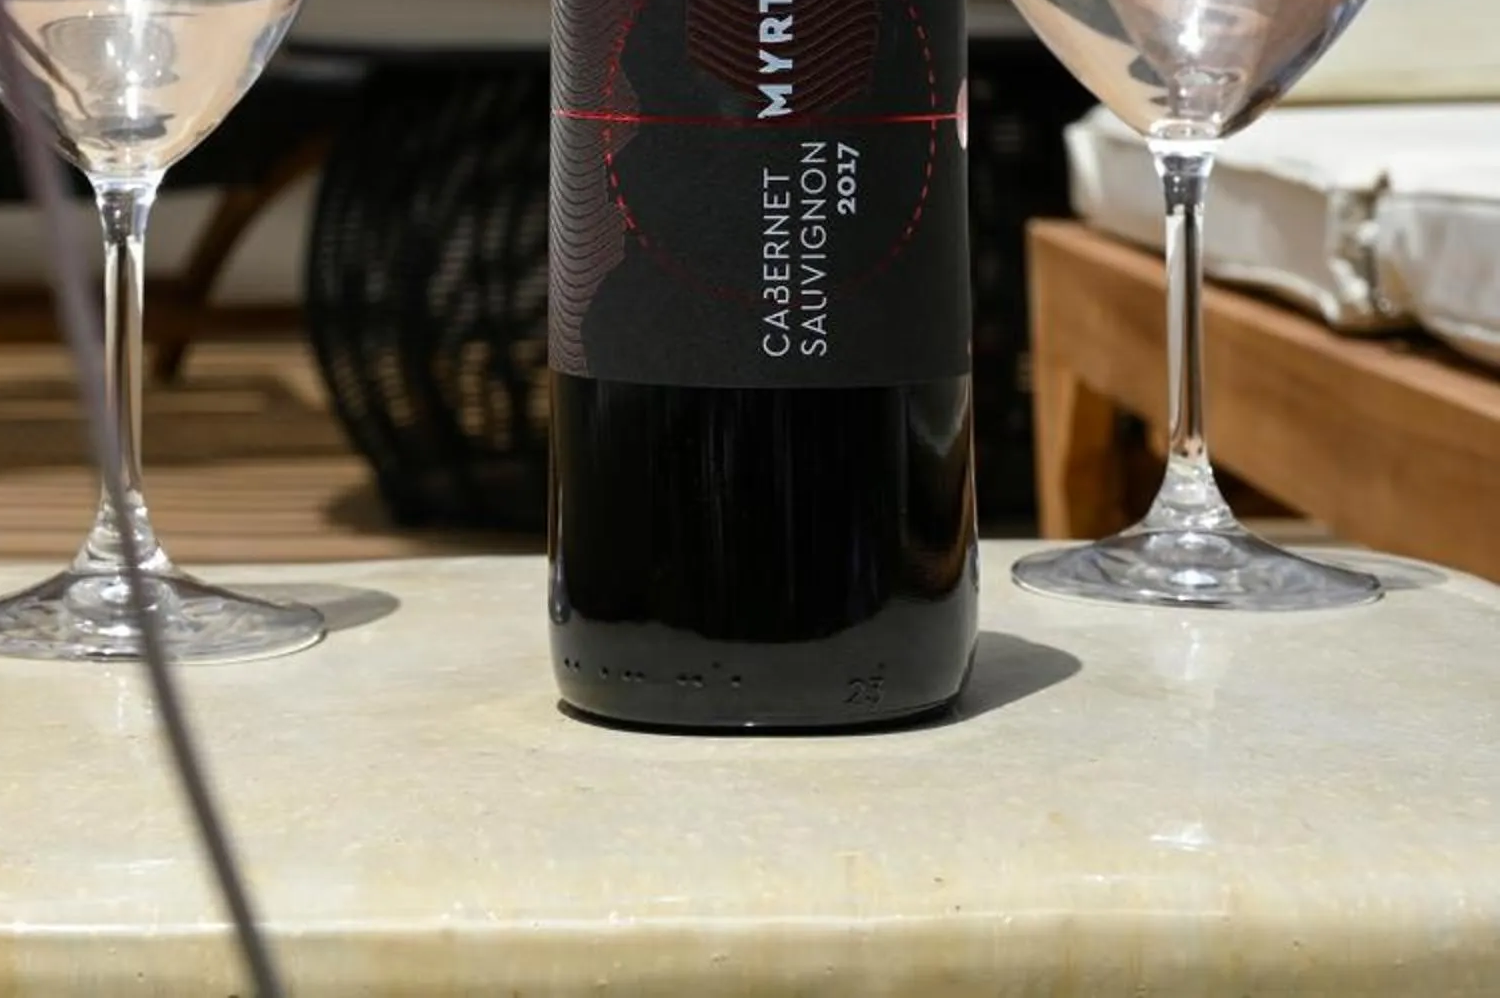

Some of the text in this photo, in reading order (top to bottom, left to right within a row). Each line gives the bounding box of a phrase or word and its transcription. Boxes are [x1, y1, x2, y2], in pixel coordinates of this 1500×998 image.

[763, 167, 790, 357] CABERNET
[801, 141, 827, 357] SAUVIGNON
[837, 142, 860, 215] 2017
